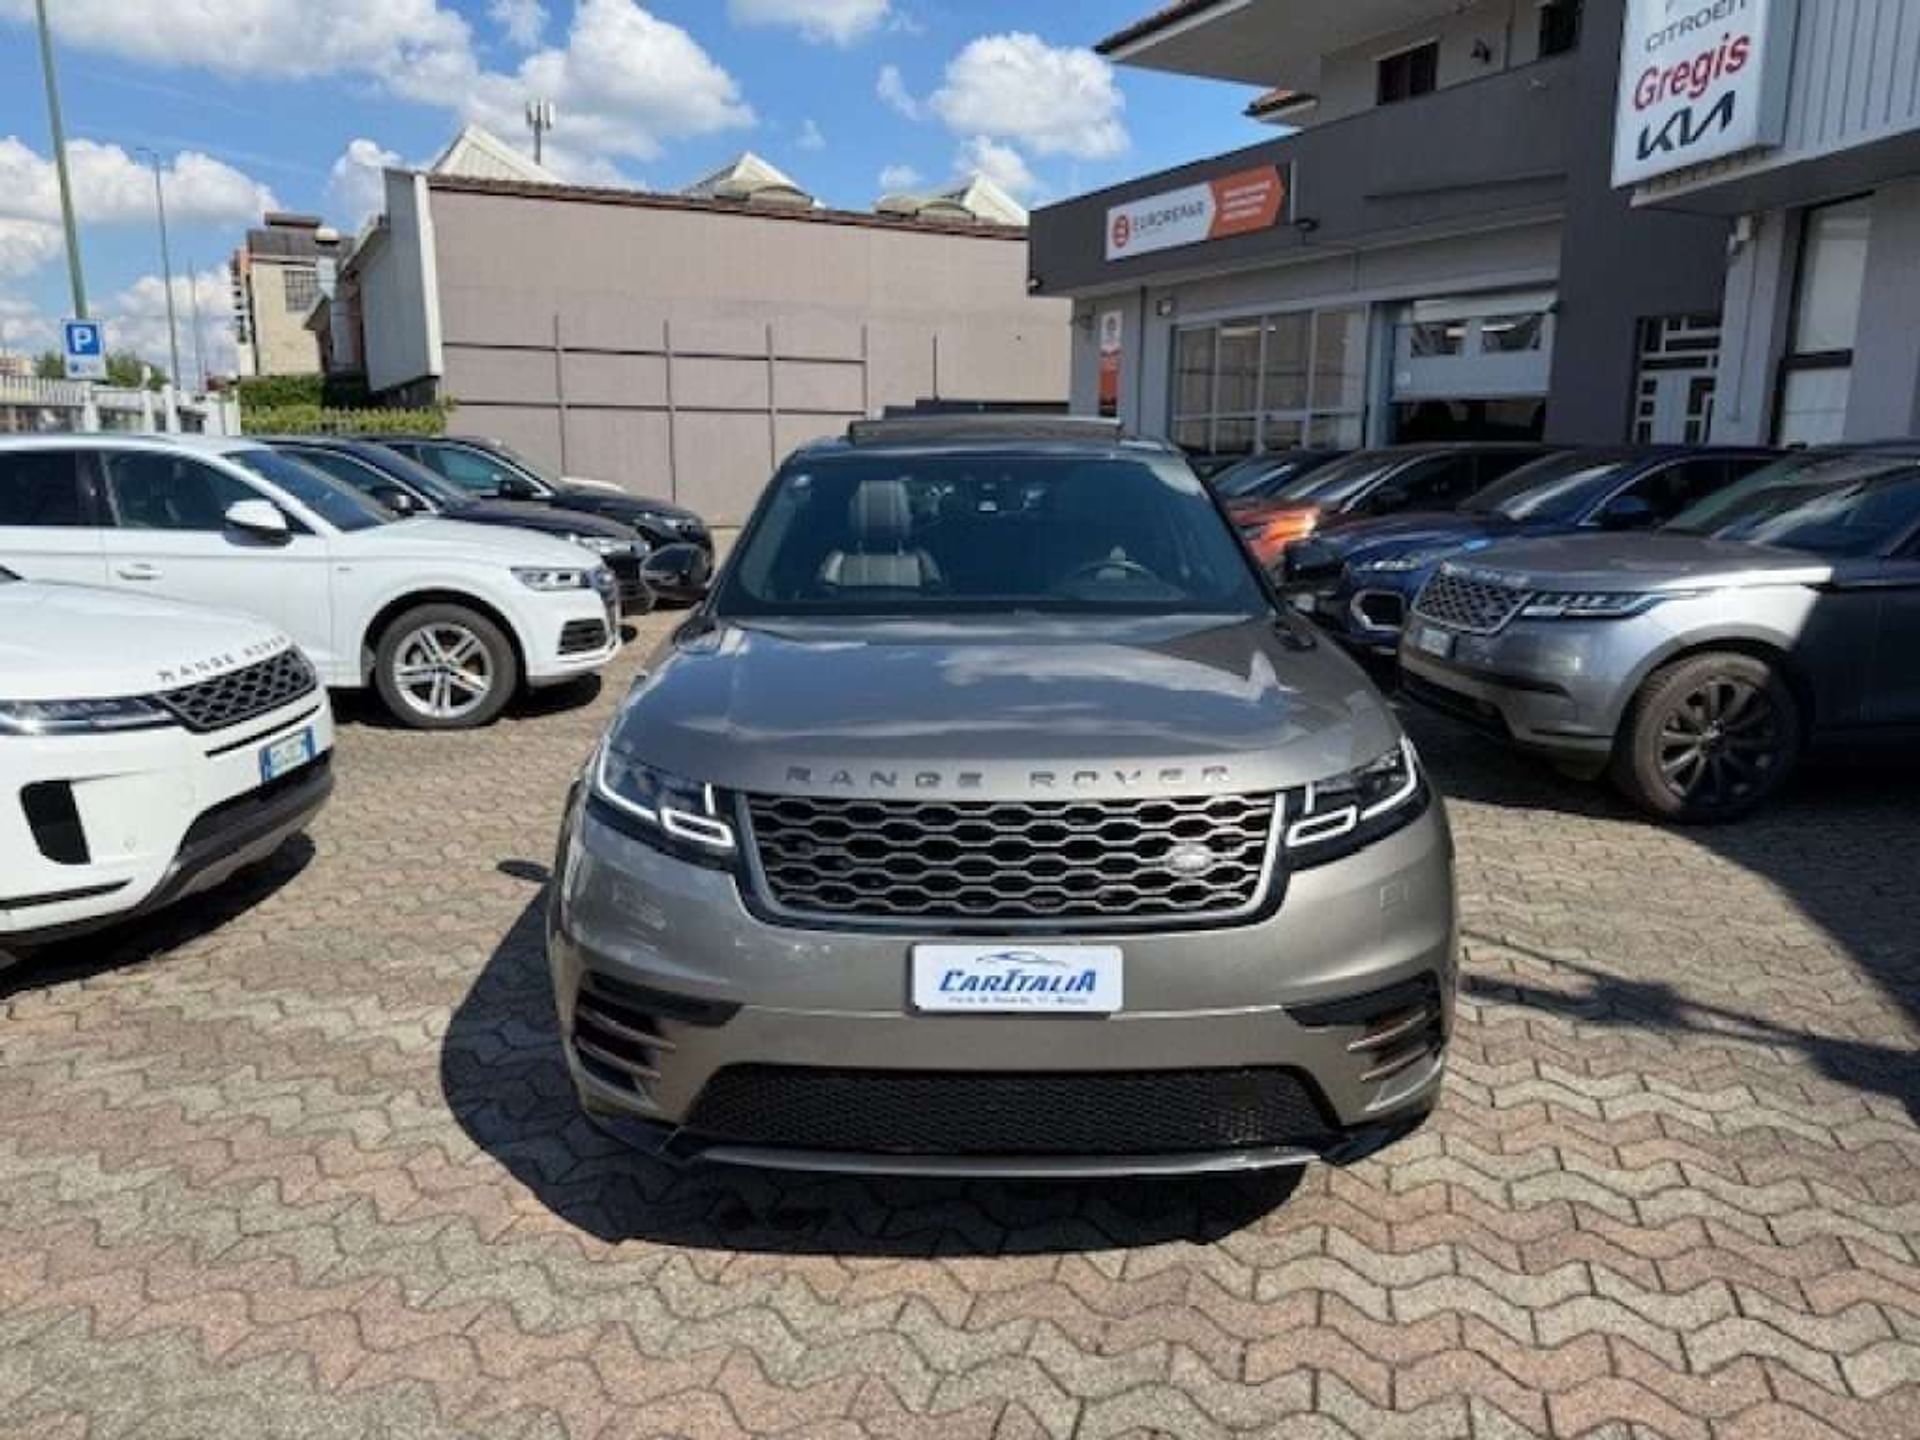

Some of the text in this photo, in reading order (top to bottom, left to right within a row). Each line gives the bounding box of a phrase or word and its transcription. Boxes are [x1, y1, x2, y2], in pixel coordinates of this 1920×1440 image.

[1635, 32, 1750, 111] Gregis
[72, 327, 92, 352] P
[785, 765, 1231, 789] RANGE ROVER
